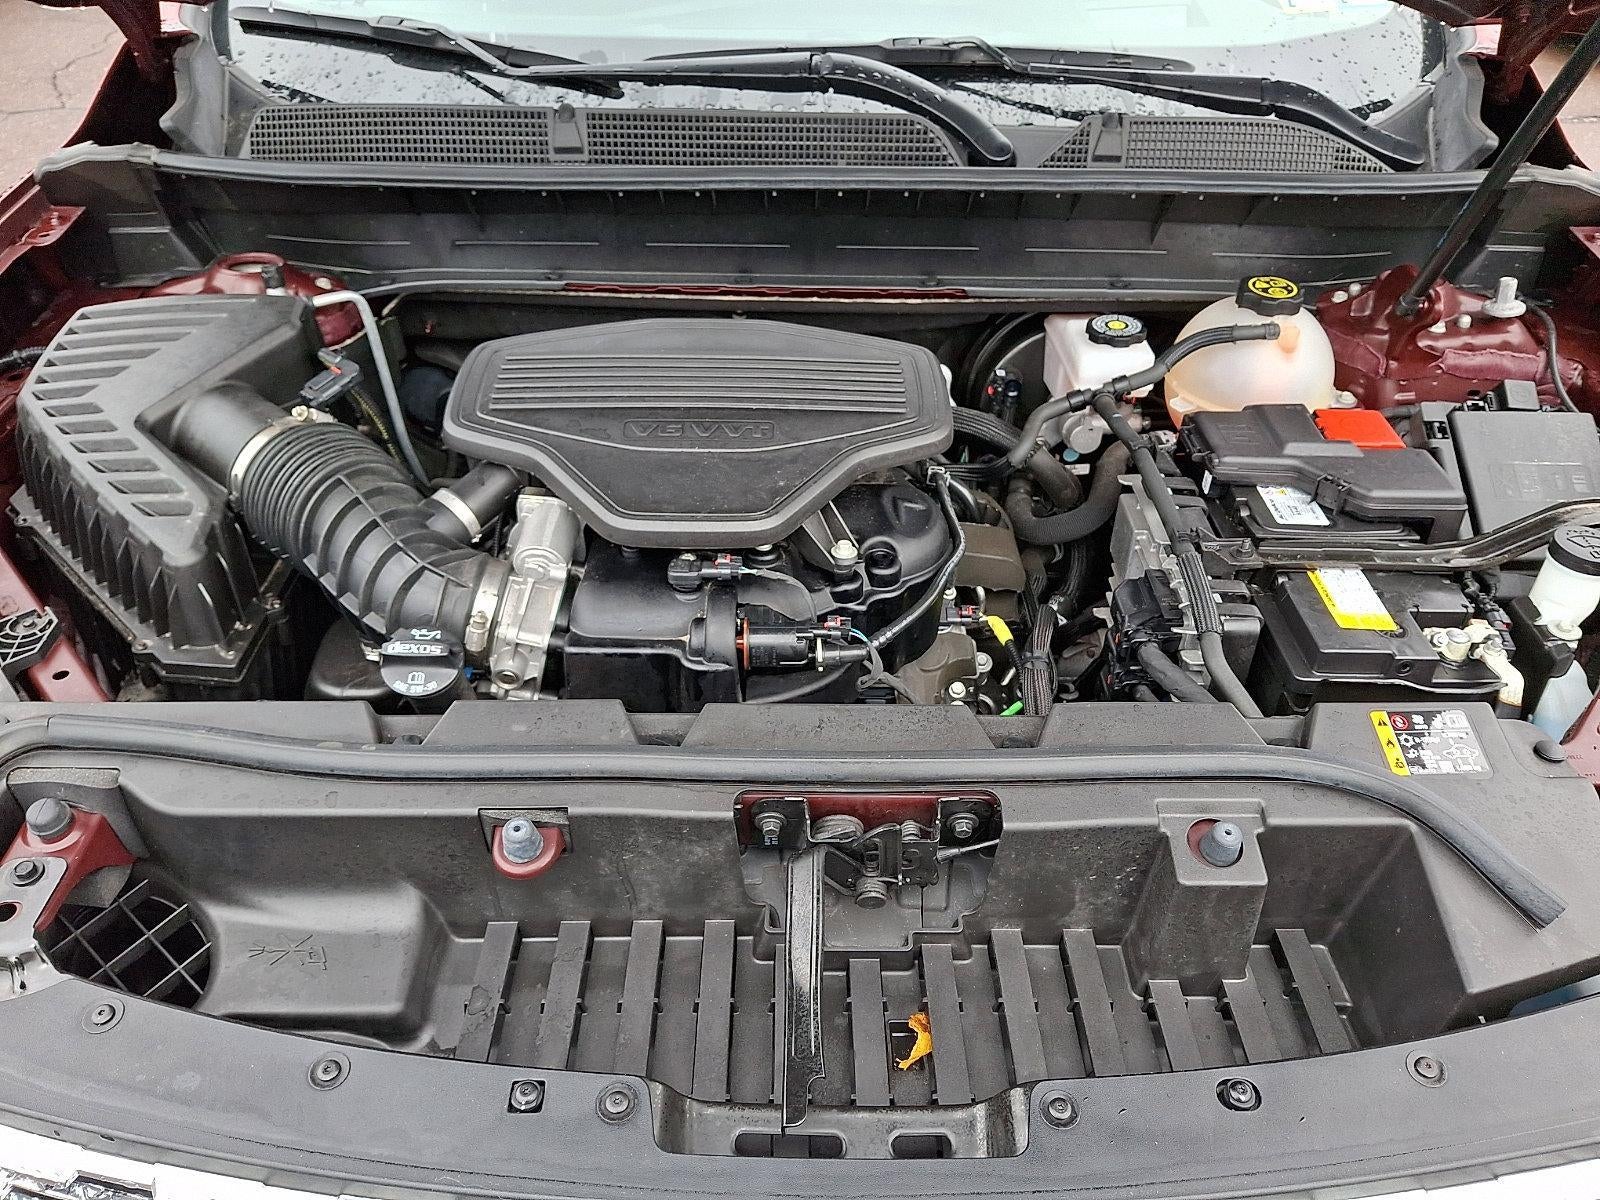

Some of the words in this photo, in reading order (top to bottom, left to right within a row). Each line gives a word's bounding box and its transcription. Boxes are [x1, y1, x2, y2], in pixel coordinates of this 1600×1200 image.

[630, 422, 684, 438] V6
[691, 422, 770, 438] VVT
[387, 640, 444, 654] dexos
